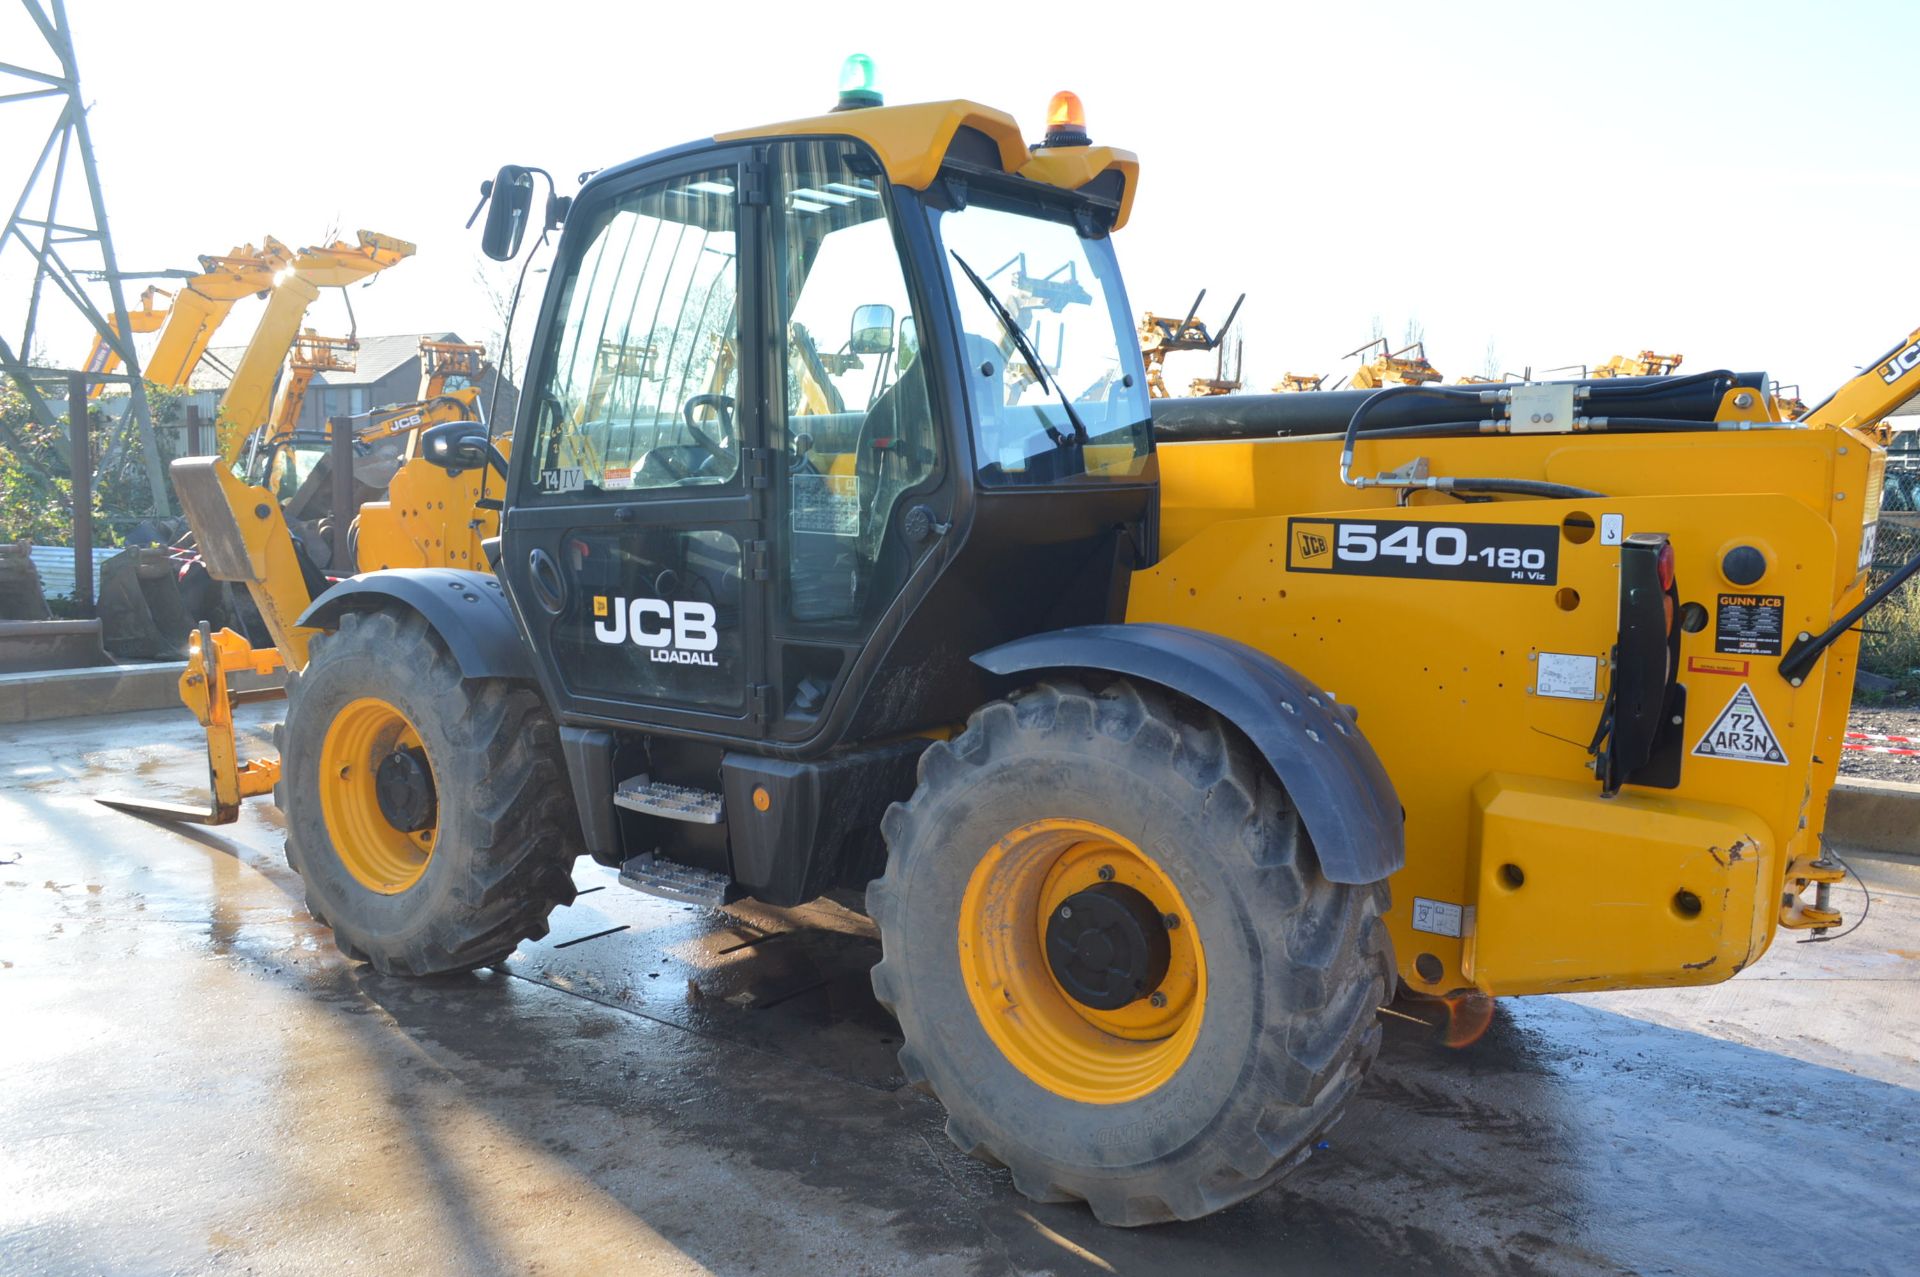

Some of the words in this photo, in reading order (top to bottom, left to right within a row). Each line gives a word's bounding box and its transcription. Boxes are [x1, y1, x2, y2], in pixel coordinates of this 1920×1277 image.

[1883, 340, 1920, 383] JC
[391, 415, 421, 431] JCB
[542, 470, 559, 489] T4
[563, 469, 581, 488] IV
[1302, 534, 1326, 554] JCB
[1337, 524, 1546, 570] 540-180
[1511, 571, 1524, 580] Hi
[1527, 571, 1546, 581] Viz
[1720, 596, 1756, 606] GUNN
[1758, 598, 1782, 607] JCB
[594, 596, 718, 651] JCB
[650, 649, 718, 666] LOADALL
[1731, 713, 1755, 732] 72
[1715, 731, 1768, 753] AR3N
